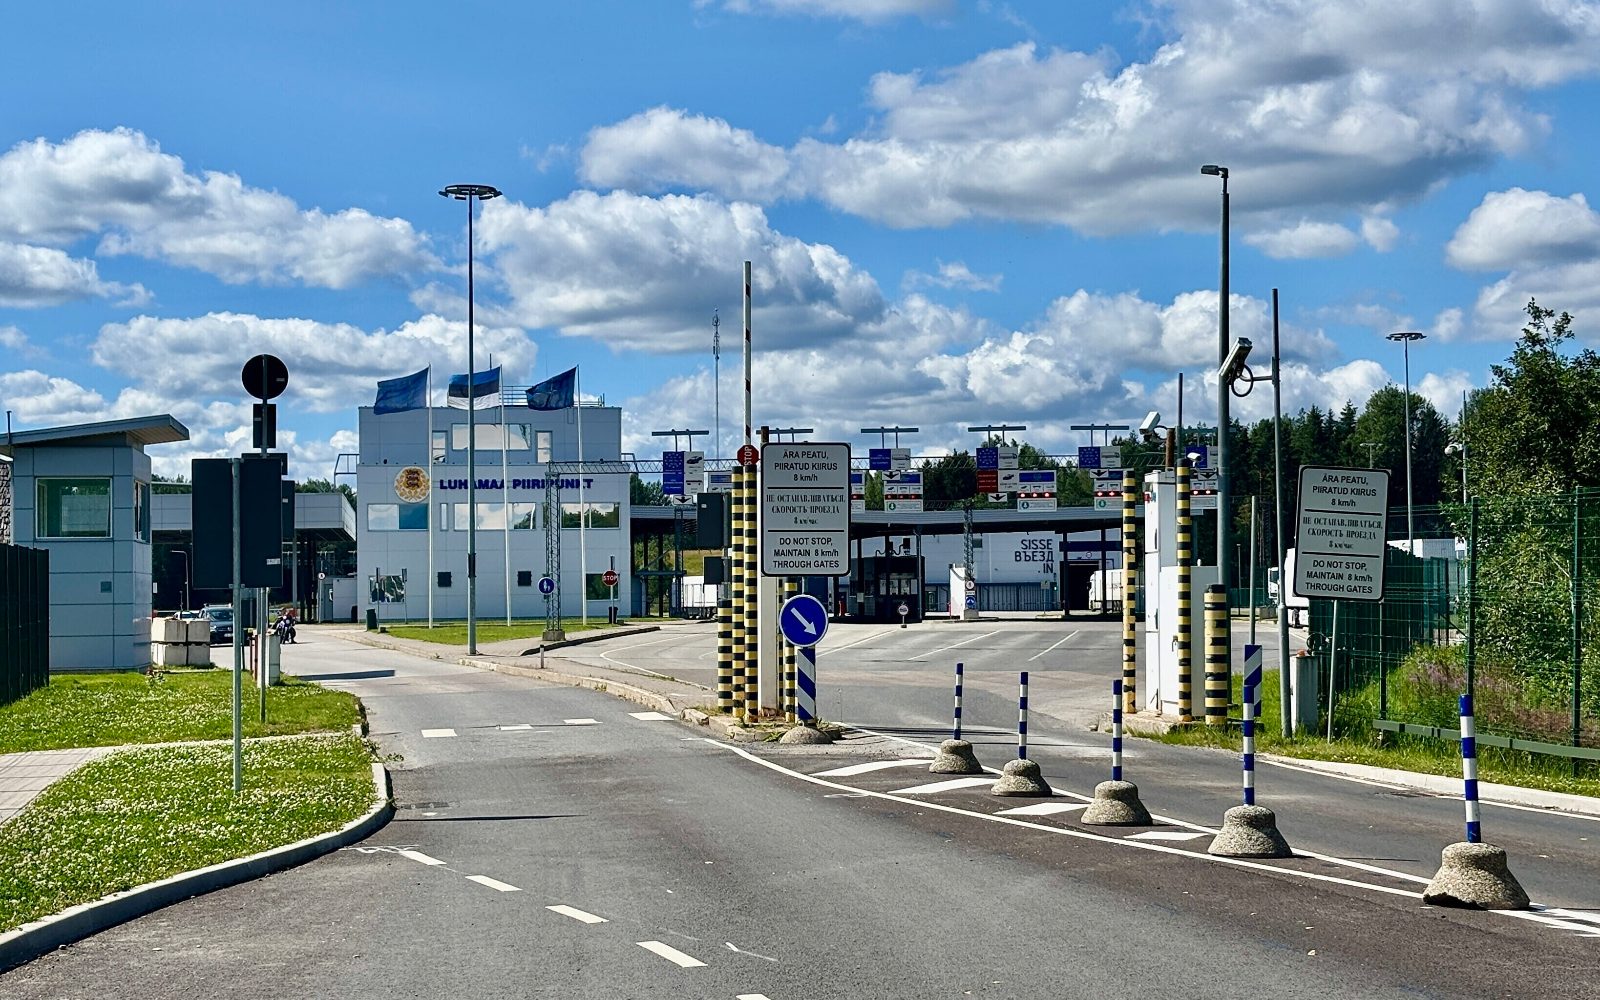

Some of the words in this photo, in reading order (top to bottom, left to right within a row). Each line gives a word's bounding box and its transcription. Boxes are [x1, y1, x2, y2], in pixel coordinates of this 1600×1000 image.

[744, 446, 752, 465] STOP
[783, 449, 800, 458] ÄRA
[802, 451, 828, 460] PEATU,
[812, 462, 838, 470] KIIRUS
[1341, 476, 1368, 485] PEATU,
[1312, 486, 1348, 494] PIIRATUD
[1350, 488, 1376, 496] KIIRUS
[772, 506, 807, 514] СКОРОСТЬ
[1308, 528, 1344, 538] СКОРОСТЬ
[811, 538, 832, 546] STOP,
[1021, 539, 1052, 550] SISSE
[1015, 551, 1054, 562] ВЪЕЗД
[1043, 563, 1053, 573] IN
[1345, 562, 1367, 571] STOP,
[1306, 571, 1344, 580] MAINTAIN
[1306, 582, 1344, 592] THROUGH
[1346, 585, 1372, 593] GATES
